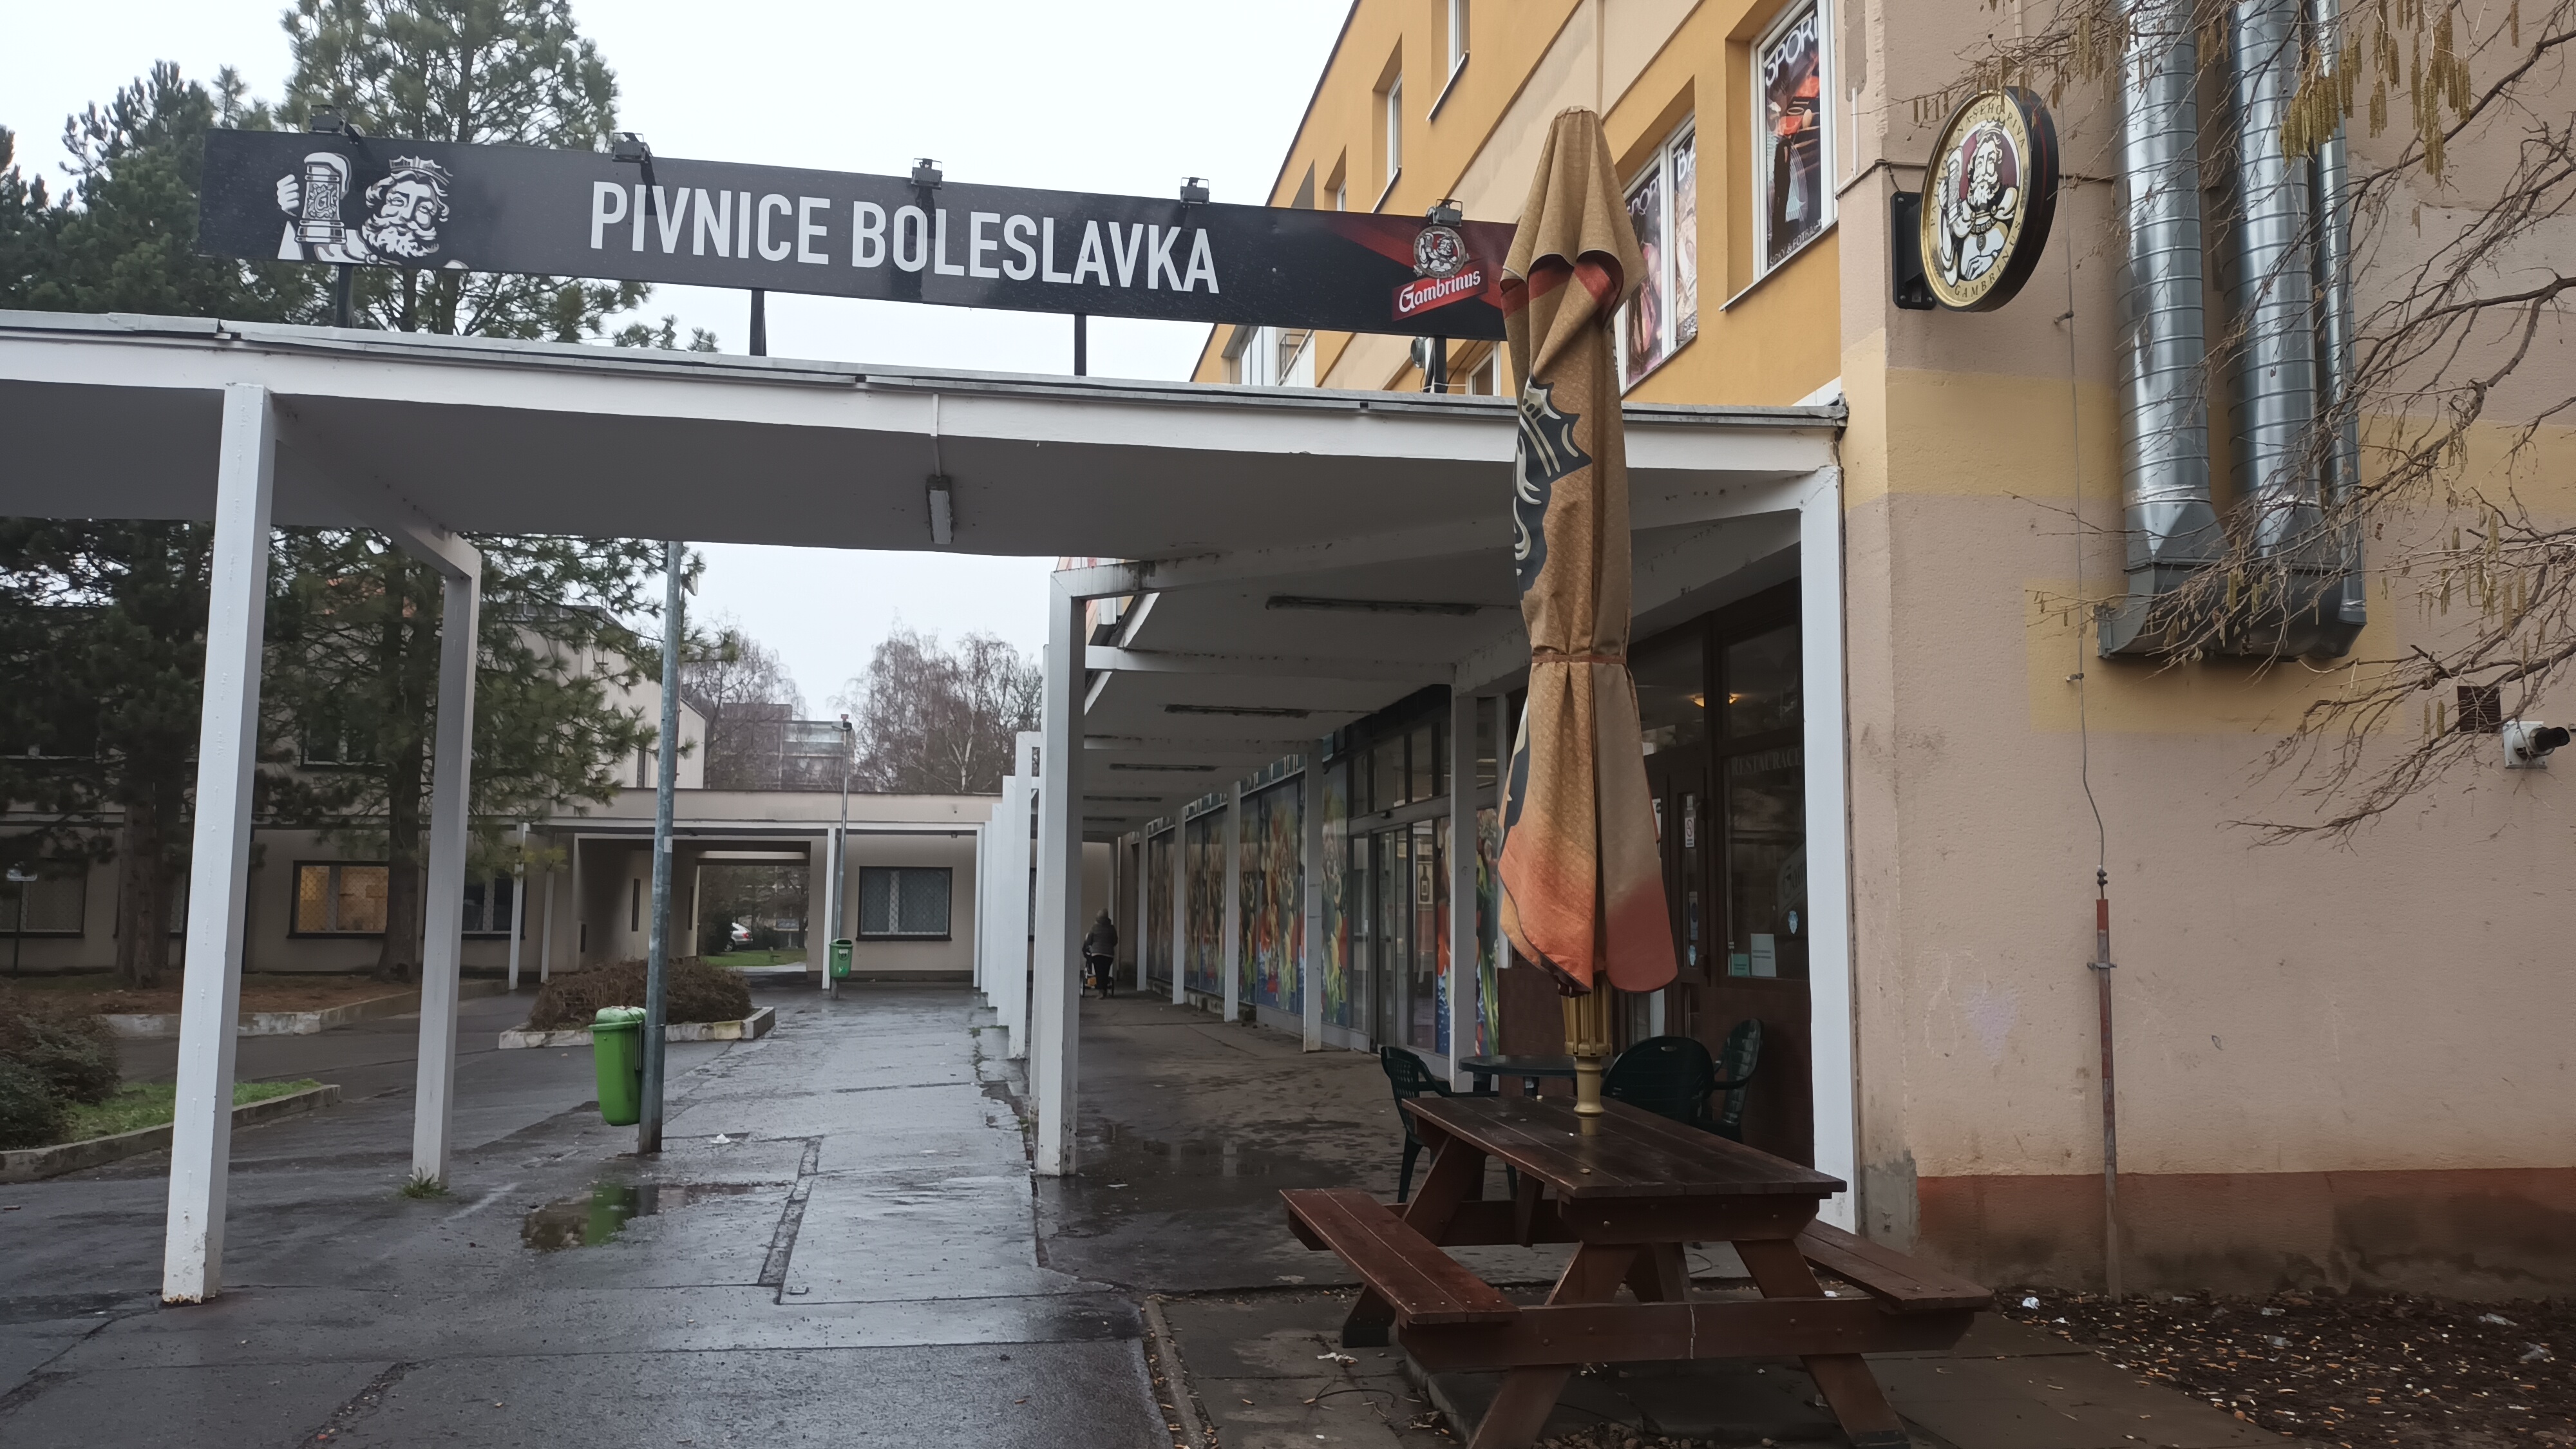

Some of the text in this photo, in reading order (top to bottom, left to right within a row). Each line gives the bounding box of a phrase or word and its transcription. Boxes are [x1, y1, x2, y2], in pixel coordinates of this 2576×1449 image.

[2007, 112, 2025, 149] PIVA
[591, 181, 1220, 294] PIVNICE BOLESLAVKA
[1399, 270, 1481, 313] Gambrinus
[1731, 747, 1802, 775] RESTAURACE
